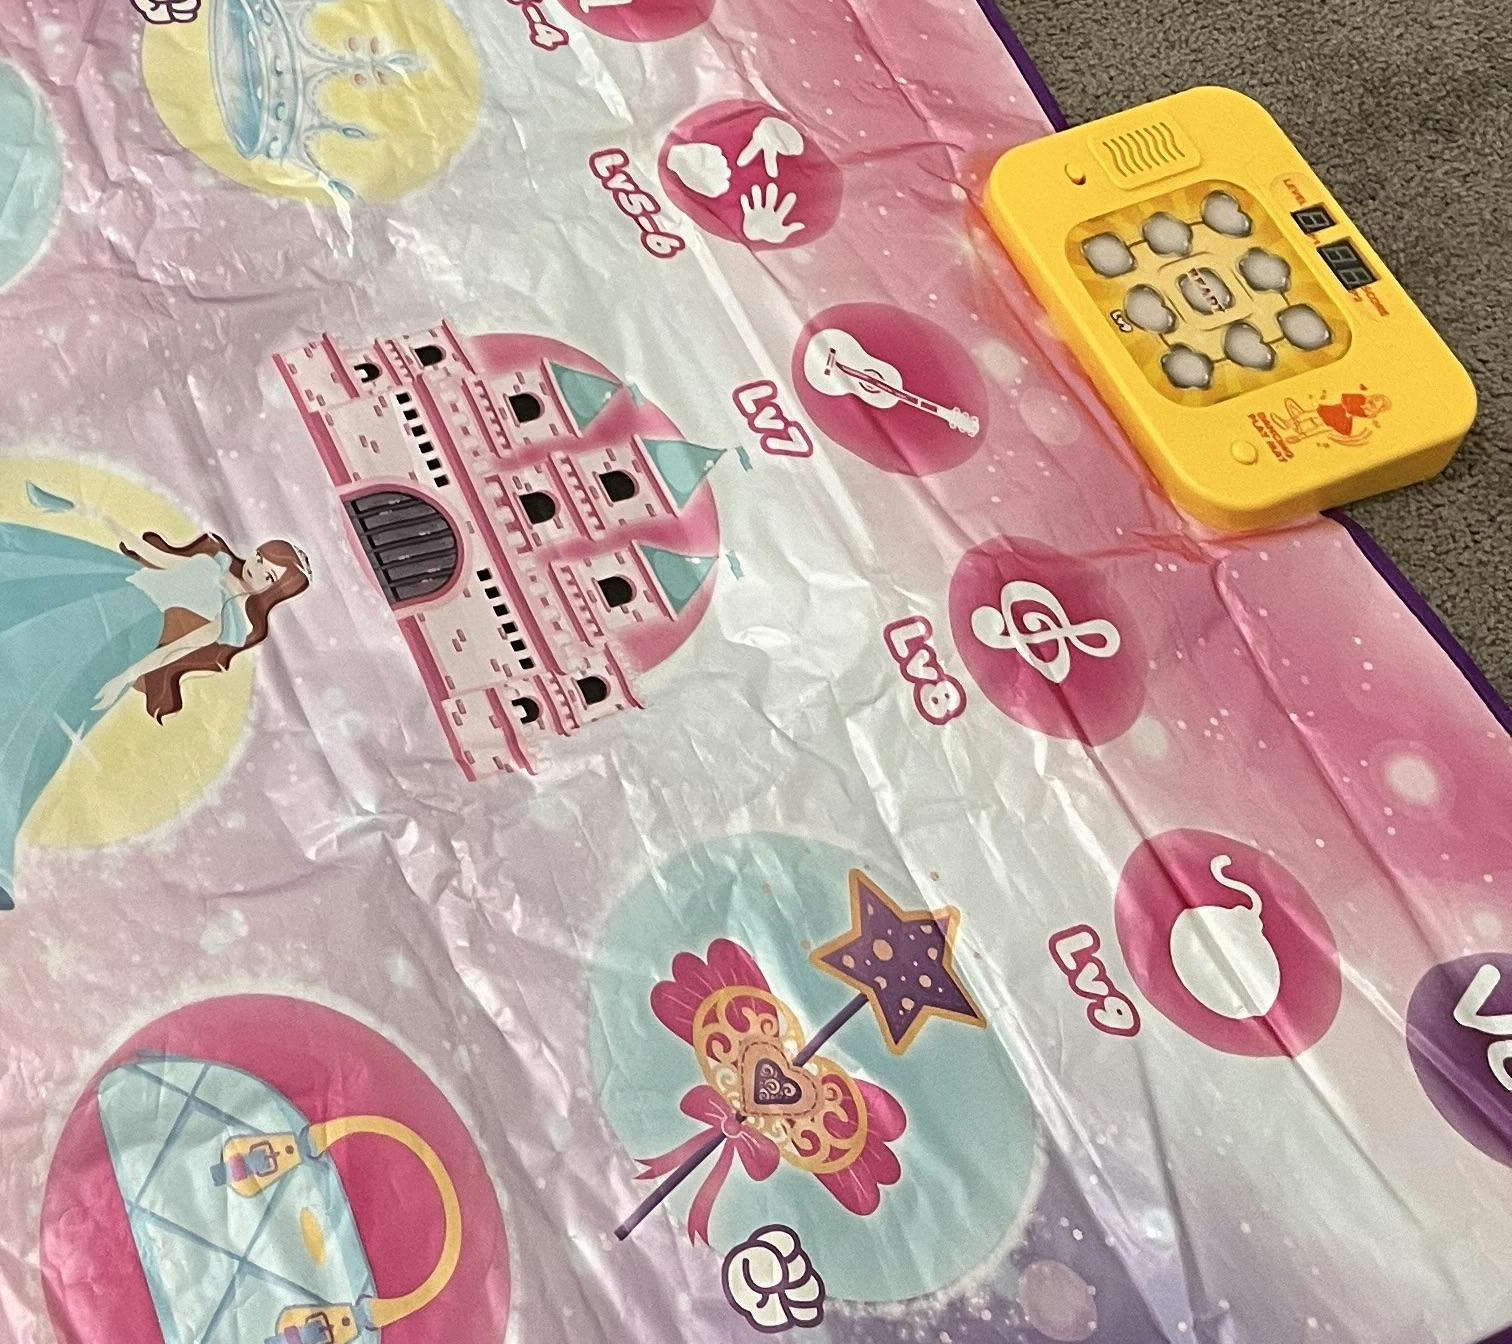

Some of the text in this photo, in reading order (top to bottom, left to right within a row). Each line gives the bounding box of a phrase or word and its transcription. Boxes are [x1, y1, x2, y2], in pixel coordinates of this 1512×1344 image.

[589, 149, 685, 258] Lv5-6
[732, 380, 813, 457] Lv7
[883, 615, 967, 725] Lv8
[1048, 924, 1141, 1037] Lv9
